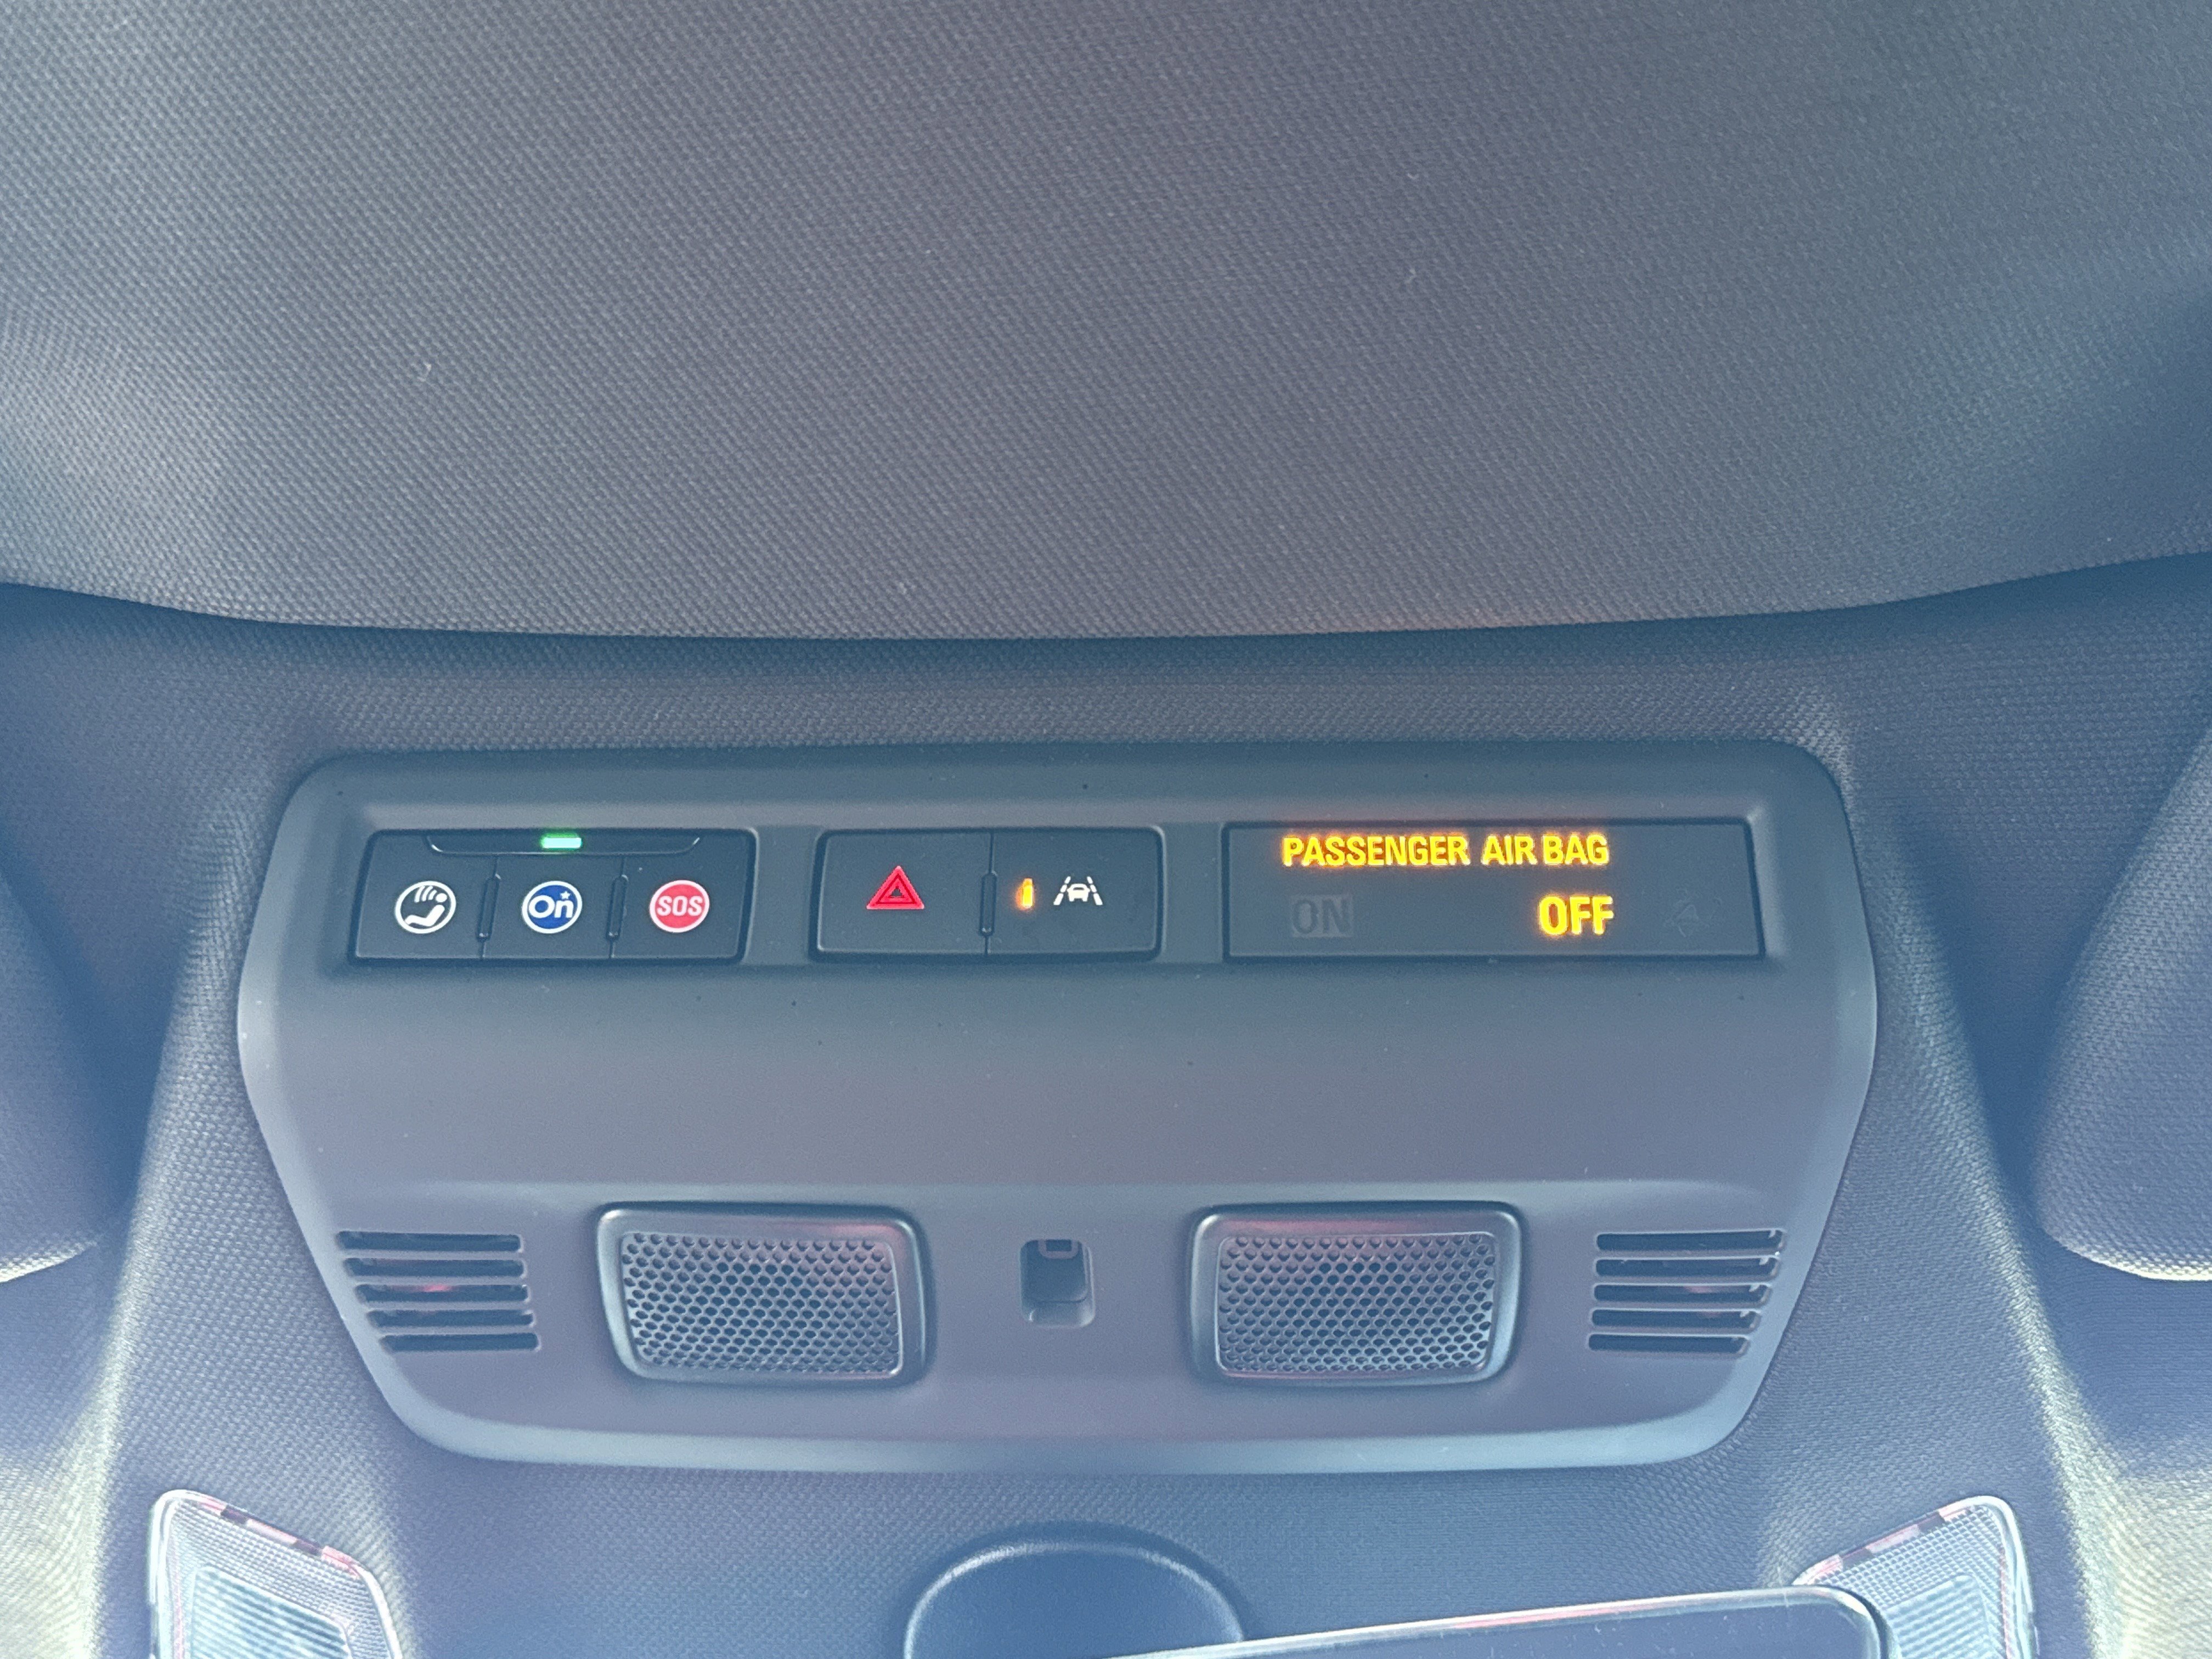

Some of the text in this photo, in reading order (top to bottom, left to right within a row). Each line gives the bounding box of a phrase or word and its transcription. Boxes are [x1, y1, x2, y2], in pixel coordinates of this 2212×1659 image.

[1282, 834, 1610, 866] PASSENGER AIR BAG
[657, 895, 703, 917] SOS
[1292, 898, 1351, 934] ON
[1538, 894, 1614, 936] OFF
